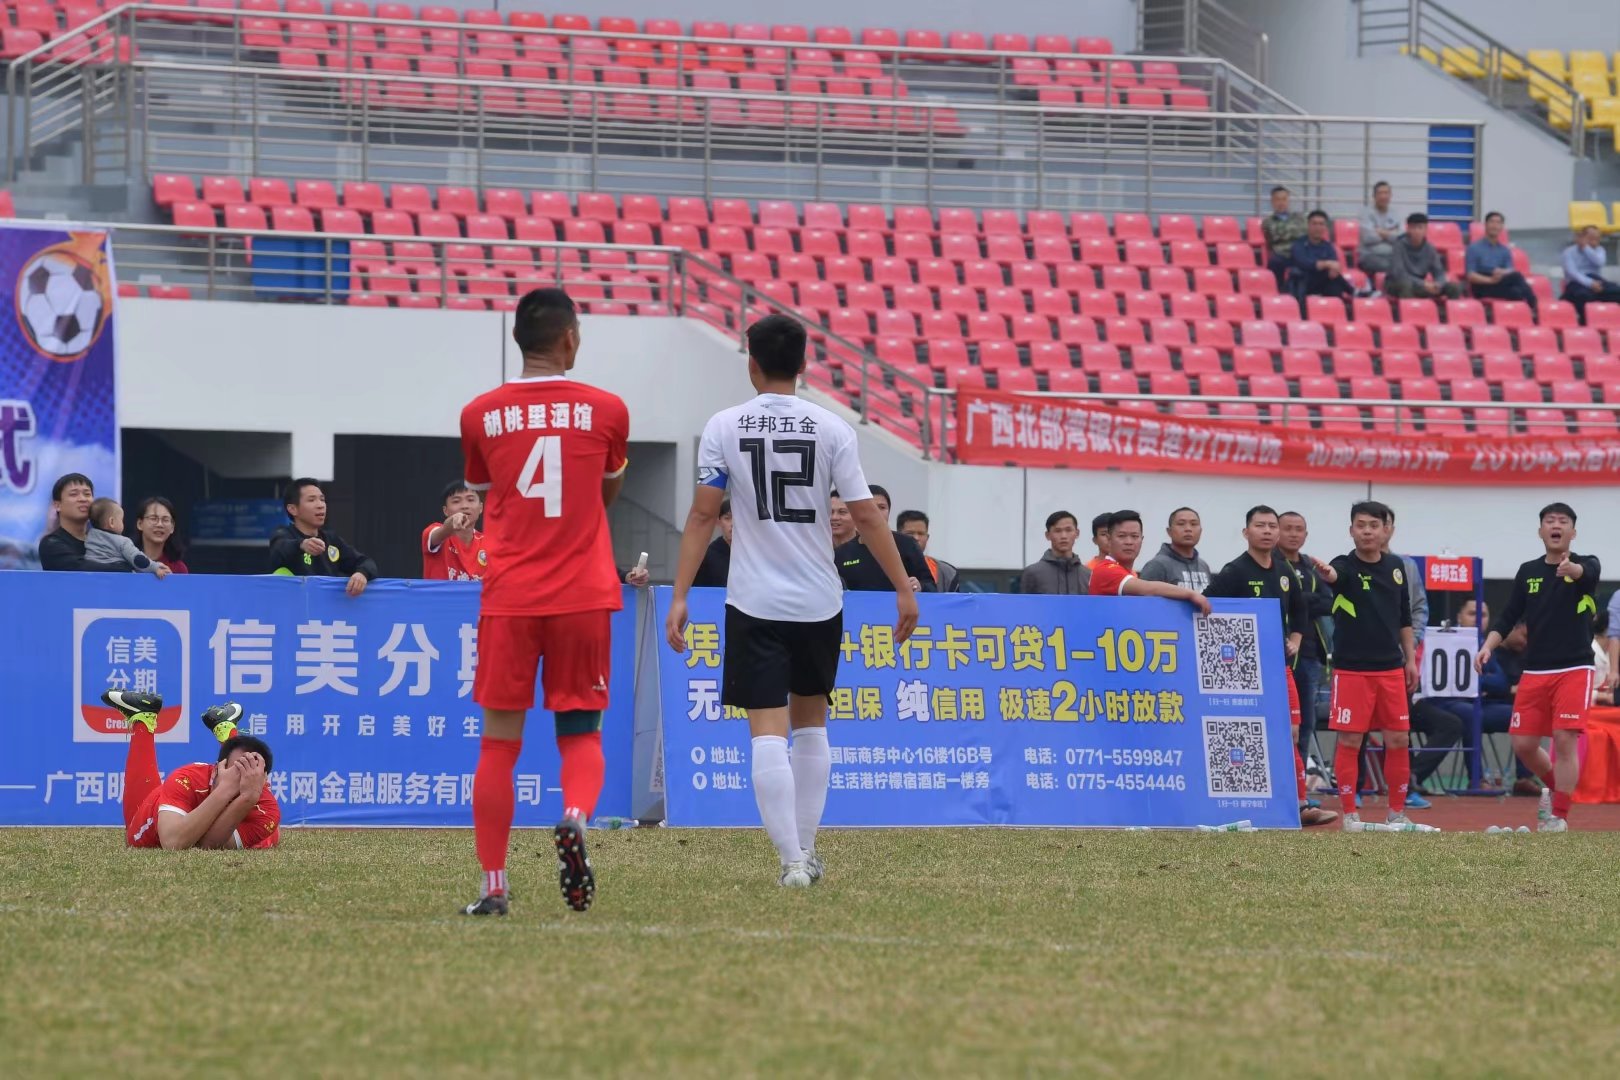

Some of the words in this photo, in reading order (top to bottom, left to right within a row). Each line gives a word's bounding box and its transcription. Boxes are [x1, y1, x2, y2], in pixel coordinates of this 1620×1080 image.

[483, 403, 593, 437] 胡桃里酒馆
[738, 414, 818, 435] 华邦五金
[516, 435, 562, 518] 4
[739, 437, 816, 523] 12
[1430, 563, 1469, 583] 华邦五金
[1253, 585, 1261, 597] 9
[1528, 582, 1540, 593] 13
[106, 636, 157, 664] 信美
[106, 668, 157, 695] 分期
[998, 679, 1186, 724] 极速2小时放款
[1336, 706, 1352, 725] 18
[1065, 748, 1183, 767] 0771-5599847
[1066, 773, 1186, 792] 0775-4554446
